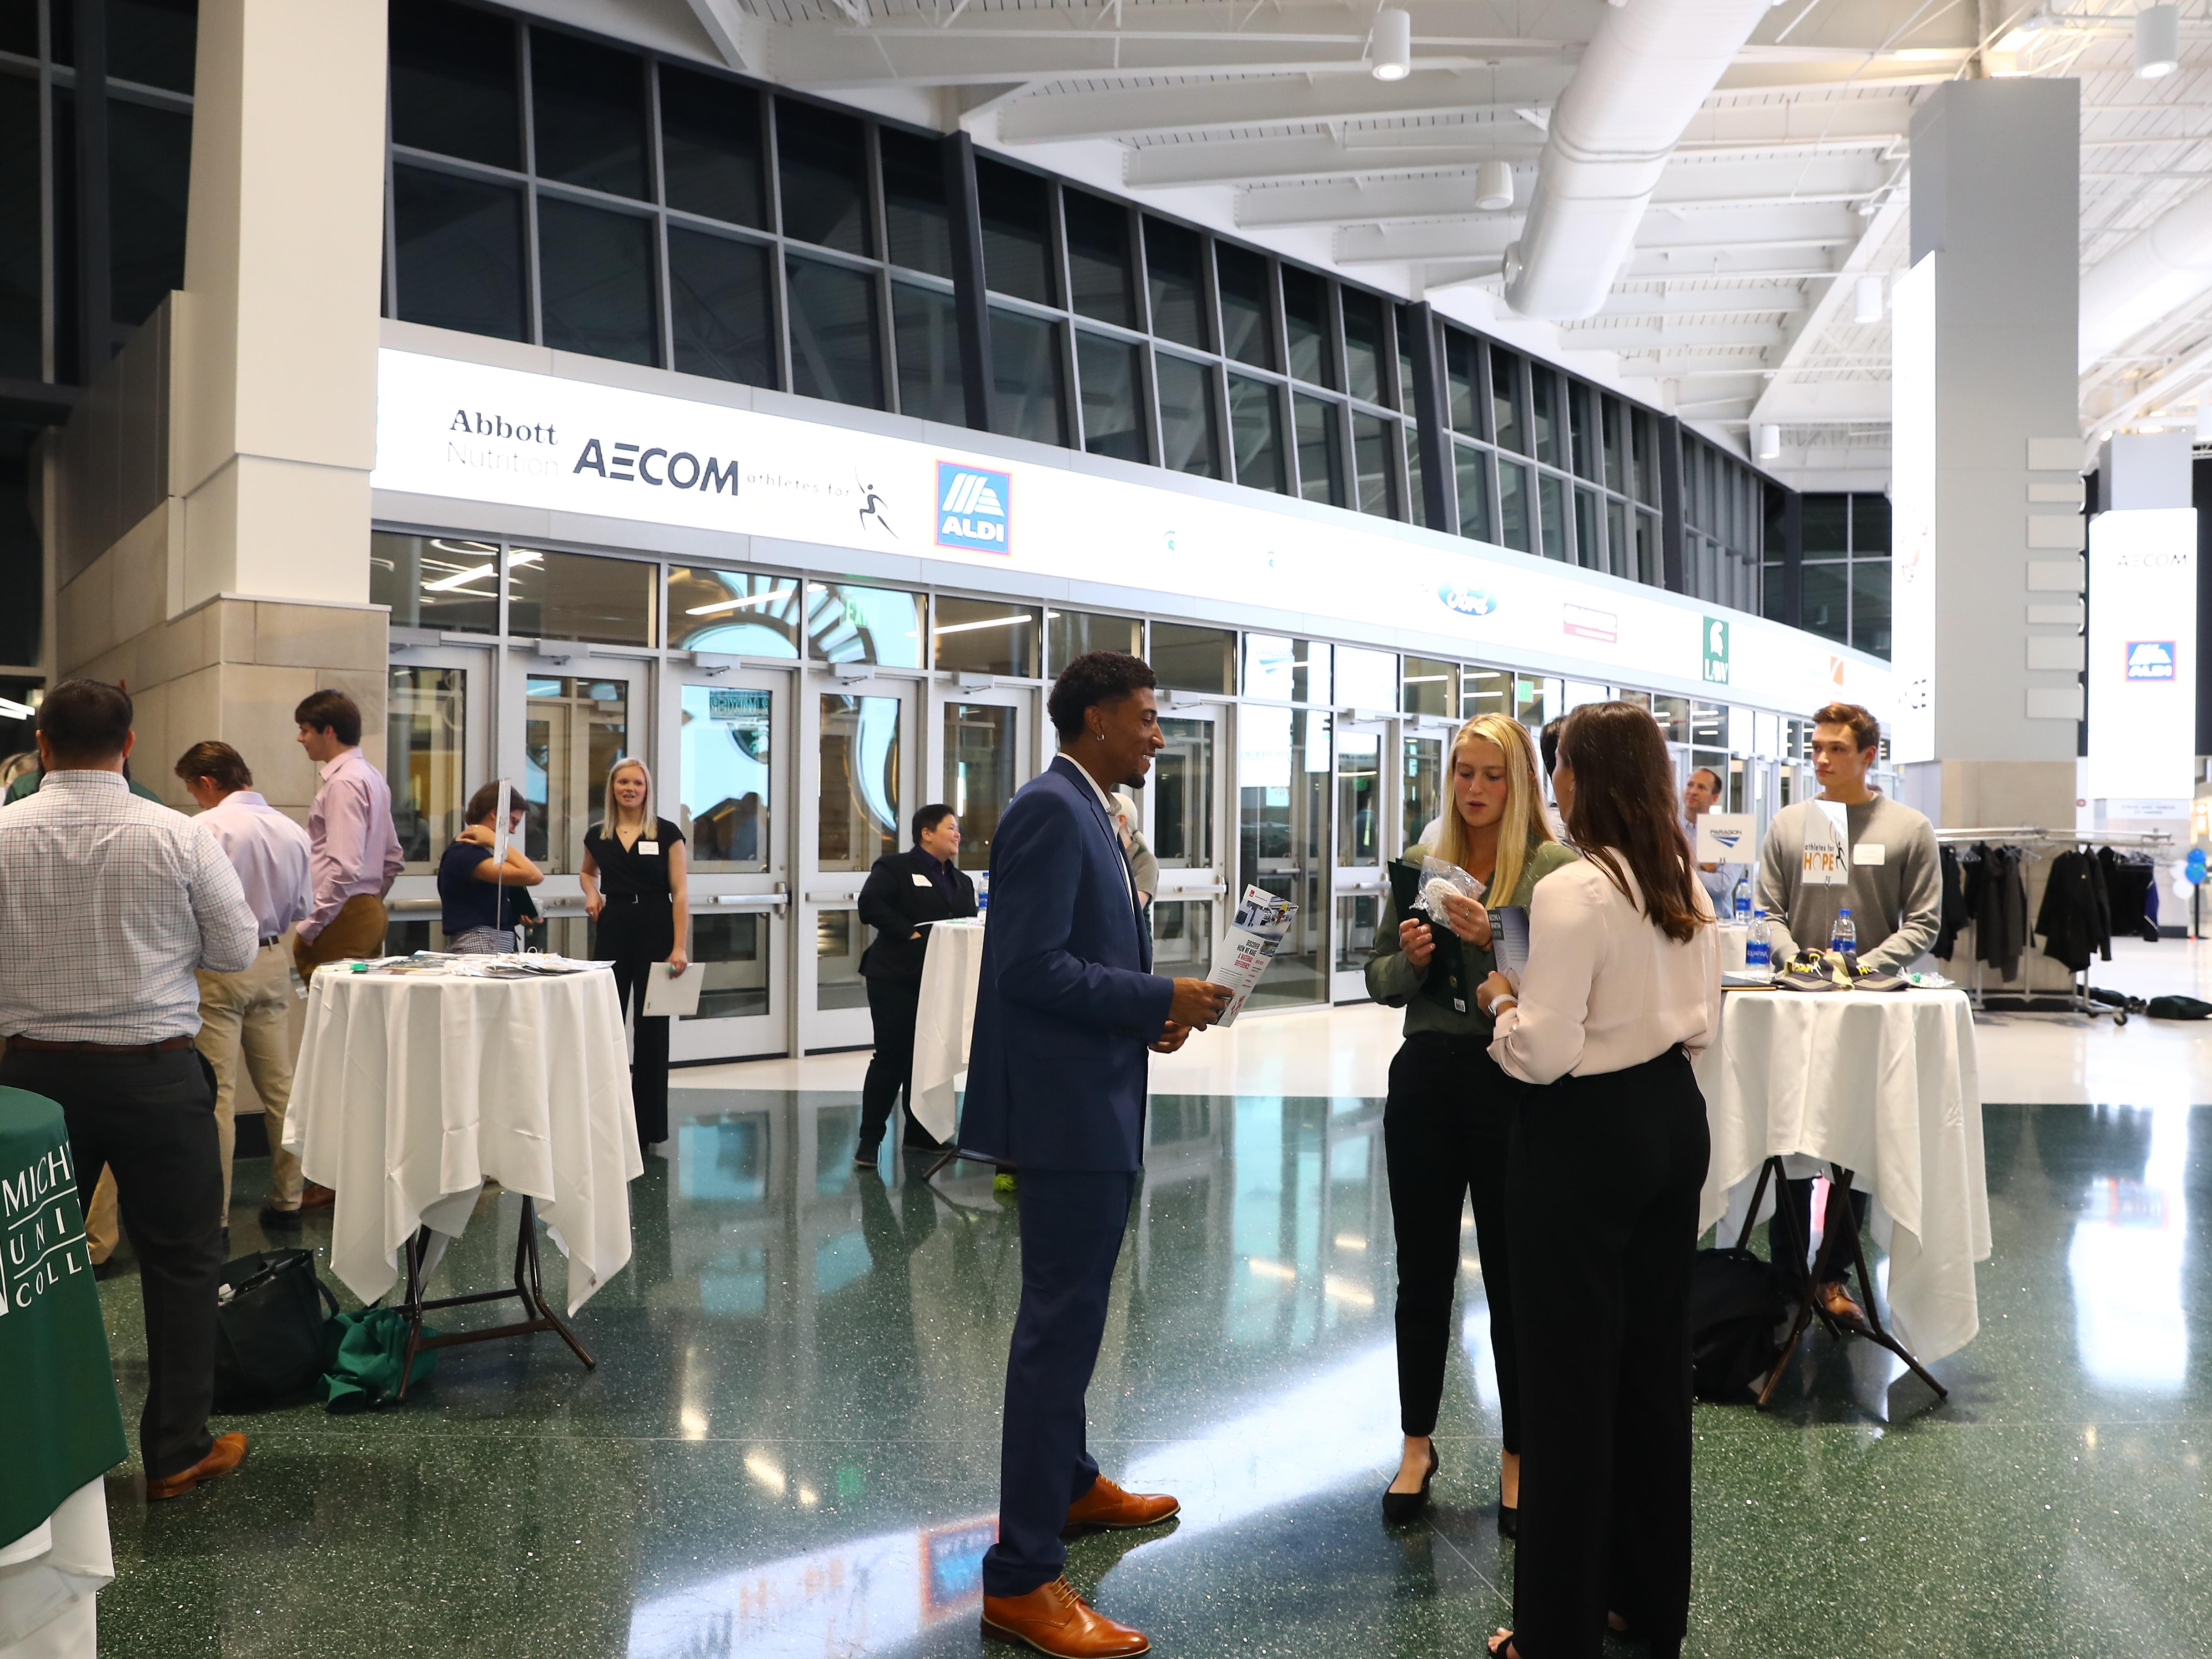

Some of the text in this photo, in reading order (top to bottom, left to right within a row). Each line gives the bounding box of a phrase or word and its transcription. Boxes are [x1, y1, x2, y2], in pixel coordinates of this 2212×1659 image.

[449, 409, 558, 445] Abbott
[447, 441, 558, 477] Nutrition
[573, 438, 739, 496] AECOM
[747, 473, 850, 497] athletes for
[941, 516, 1005, 543] ALDI
[2117, 553, 2187, 567] AECOM
[1446, 584, 1489, 615] Ford
[1804, 852, 1835, 871] HOPE
[1805, 843, 1825, 851] athletes
[2, 1141, 75, 1217] MICH
[10, 1201, 79, 1265] UNI
[16, 1245, 90, 1308] COLL
